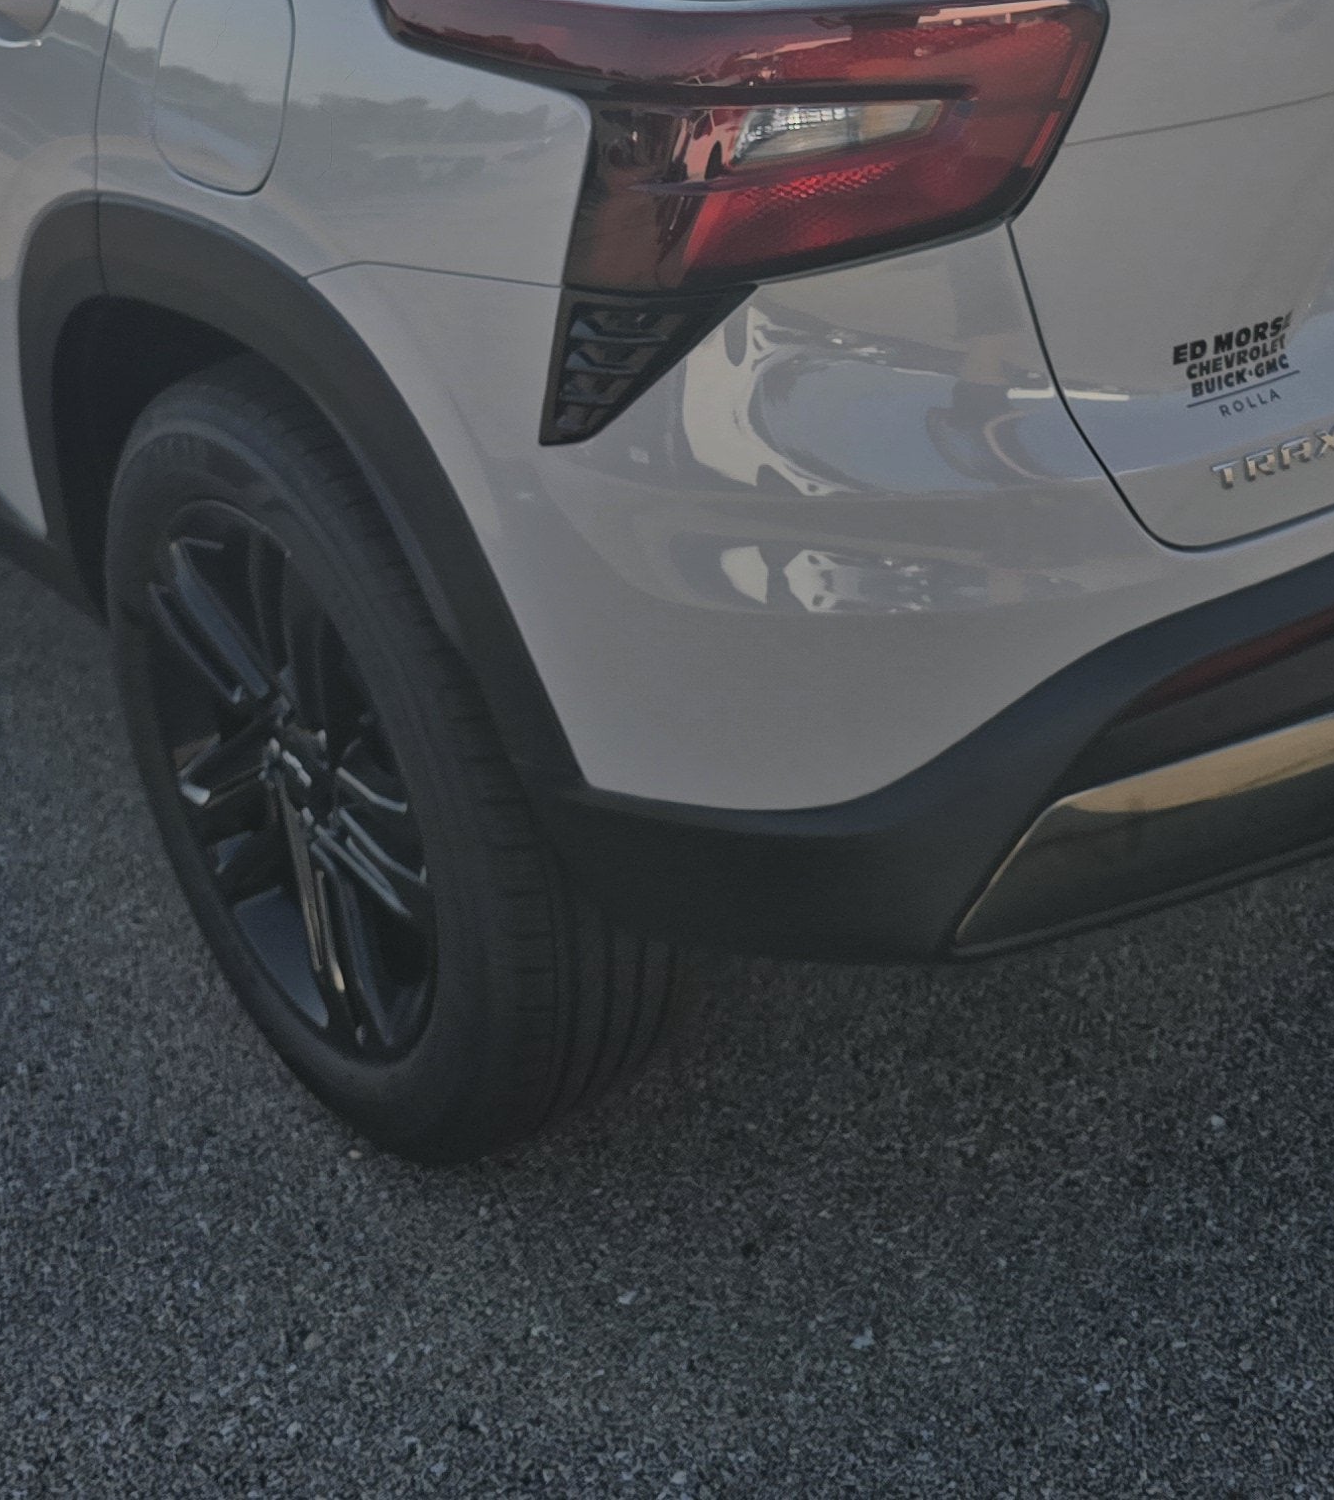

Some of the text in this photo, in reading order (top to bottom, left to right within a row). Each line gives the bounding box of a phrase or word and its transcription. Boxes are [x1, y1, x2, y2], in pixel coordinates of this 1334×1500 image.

[1172, 310, 1293, 365] ED MORSE
[1186, 332, 1286, 381] CHEVROLET
[1218, 387, 1282, 417] ROLLA
